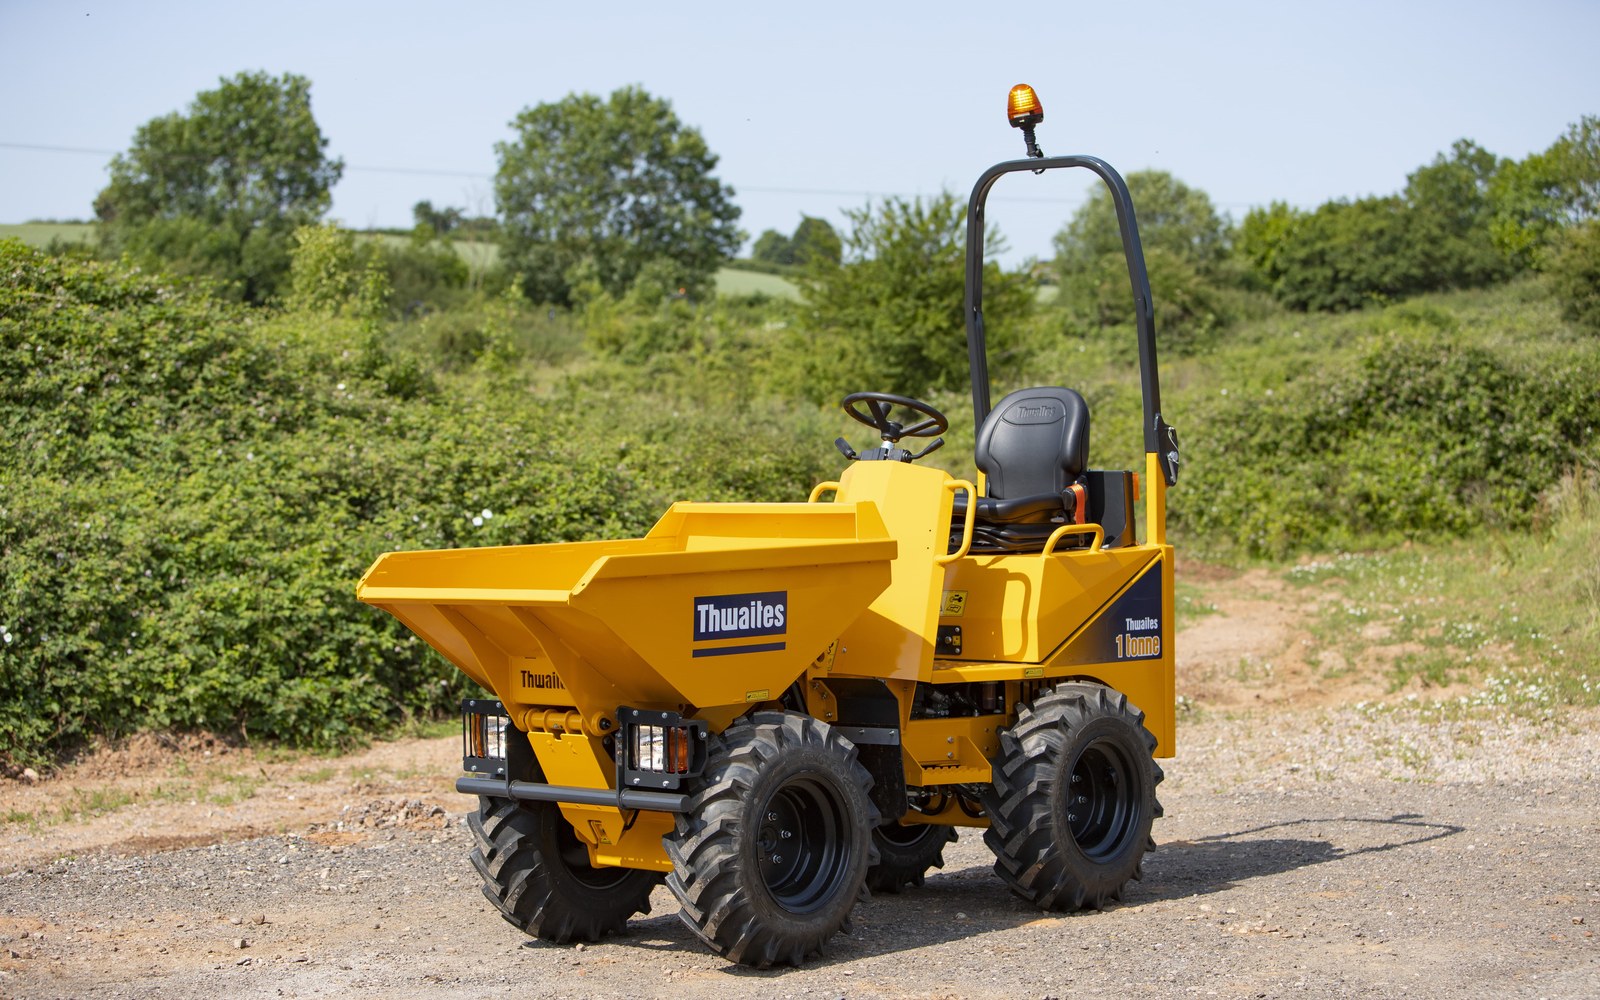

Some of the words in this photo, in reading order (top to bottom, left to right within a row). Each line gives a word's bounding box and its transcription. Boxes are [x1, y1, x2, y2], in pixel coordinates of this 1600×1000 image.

[697, 600, 785, 633] Thwaites
[1125, 616, 1159, 631] Thwaites
[1115, 634, 1123, 658] 1
[1125, 633, 1160, 658] tonne
[520, 670, 566, 690] Thwait
